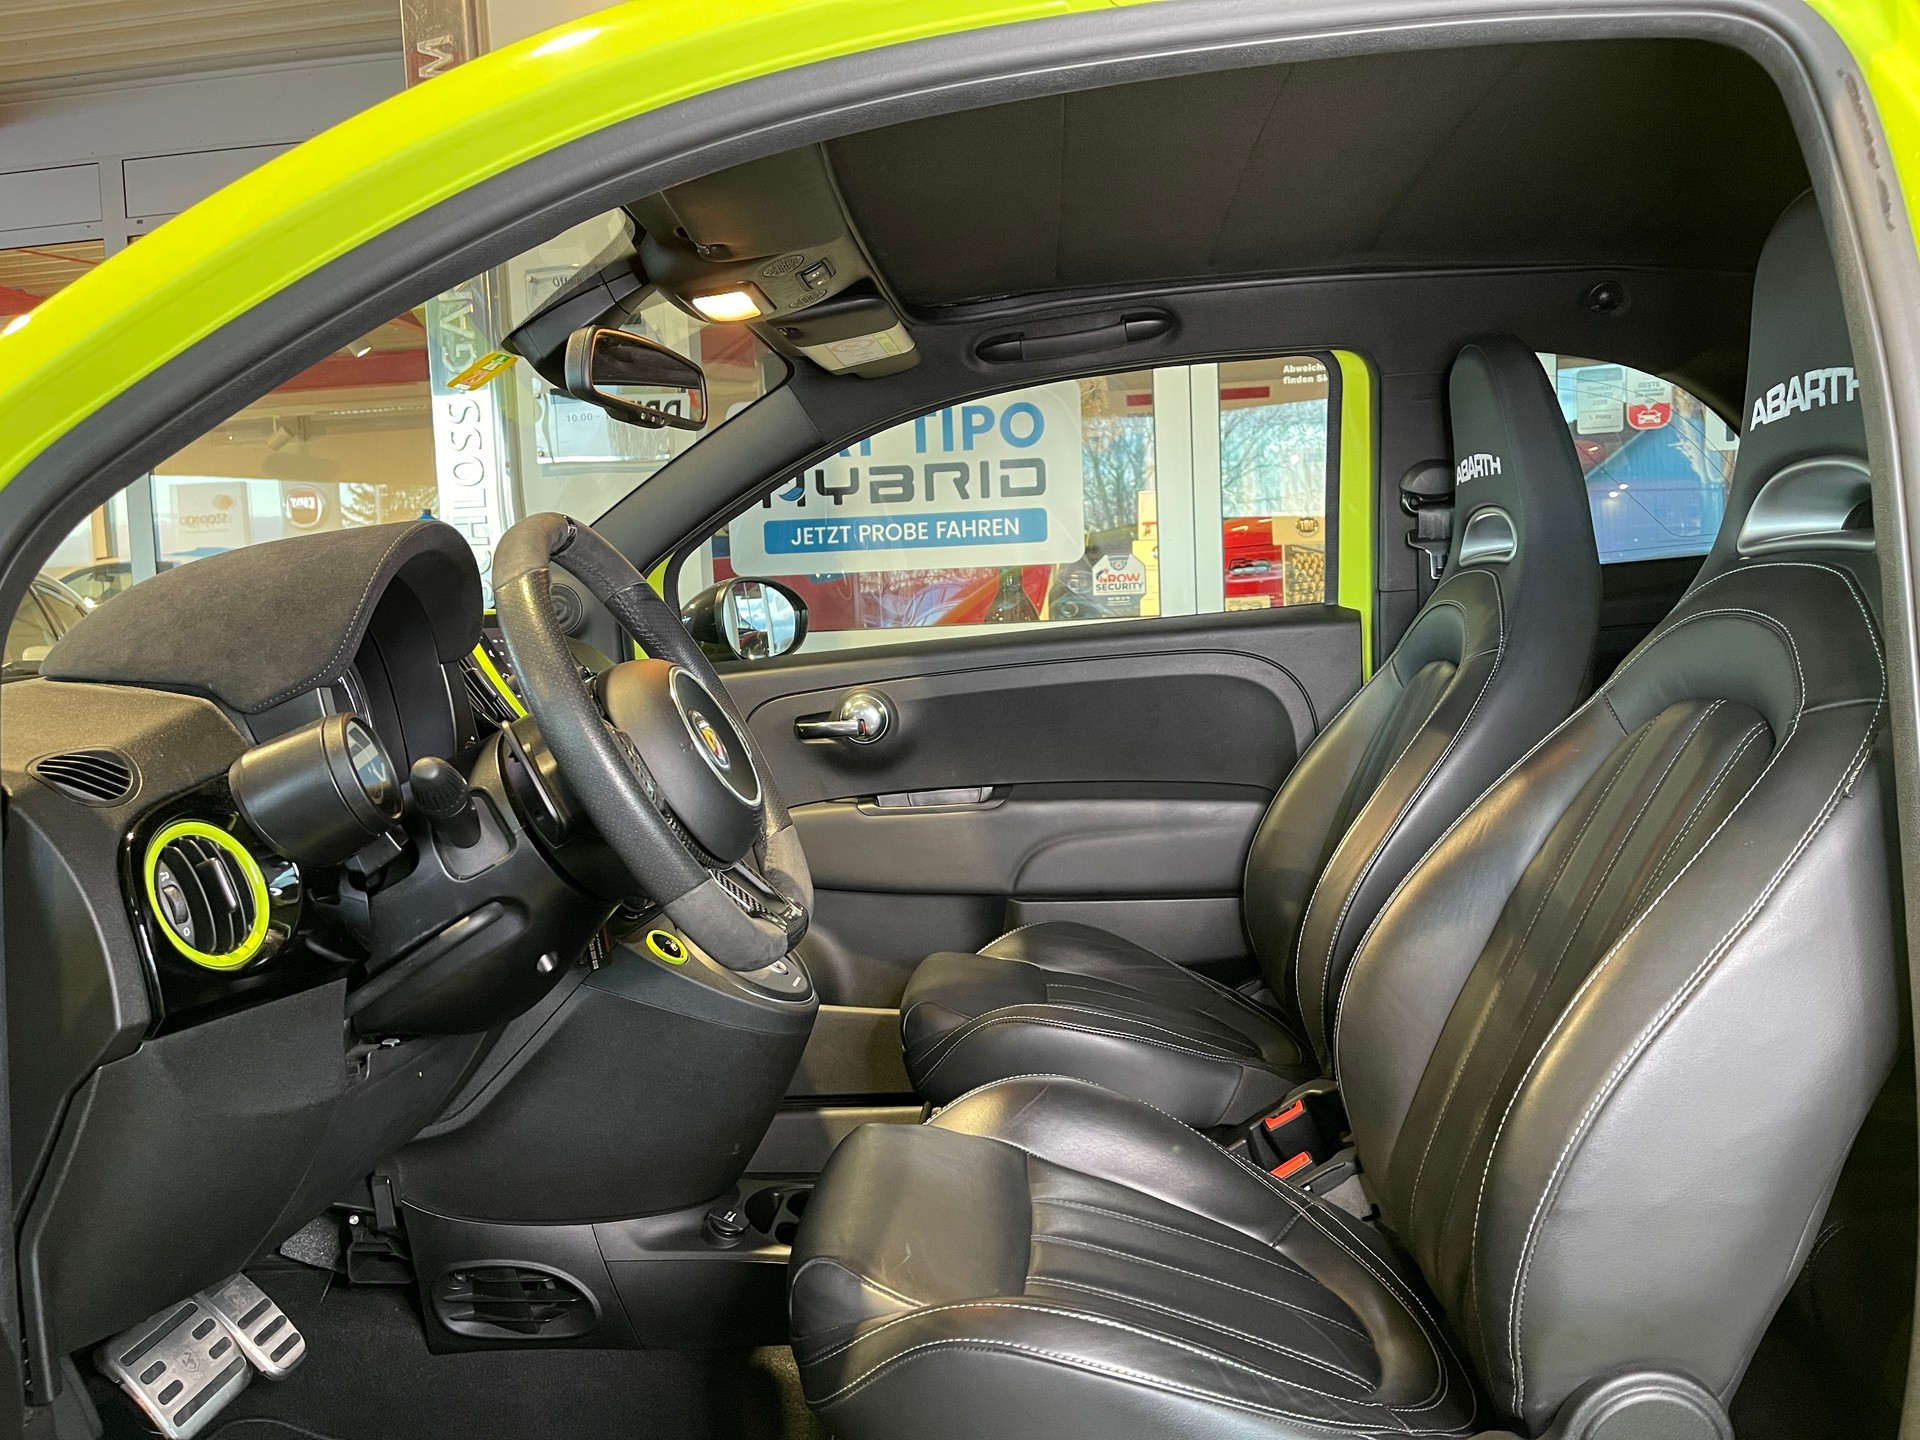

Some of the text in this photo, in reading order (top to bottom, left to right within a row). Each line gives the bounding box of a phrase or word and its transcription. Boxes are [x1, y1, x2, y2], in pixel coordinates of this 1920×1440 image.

[1283, 375, 1314, 385] finden
[566, 412, 593, 423] 10.00
[914, 401, 1045, 454] TIPO
[762, 457, 1047, 508] HYBRID
[1456, 453, 1502, 486] ABARTH
[790, 517, 1020, 546] JETZT PROBE FAHREN
[1096, 582, 1144, 591] SECURITY
